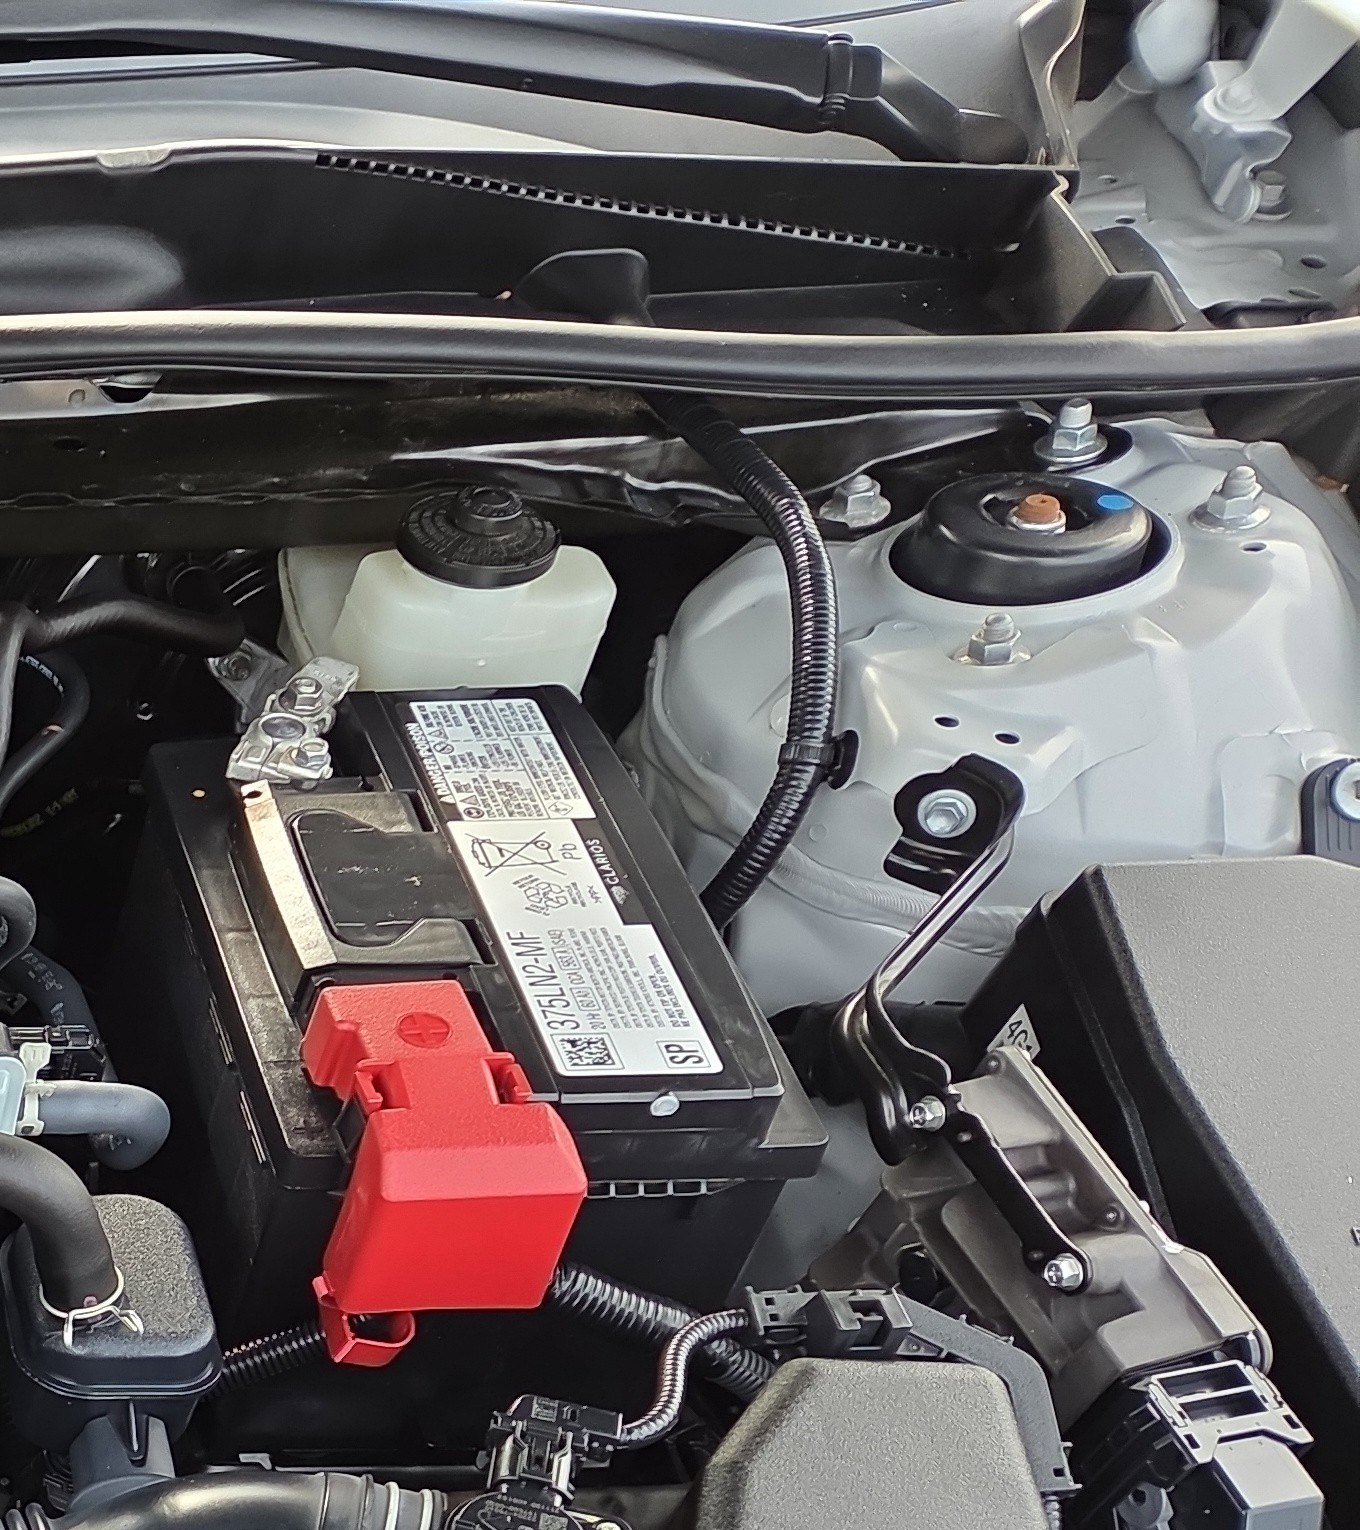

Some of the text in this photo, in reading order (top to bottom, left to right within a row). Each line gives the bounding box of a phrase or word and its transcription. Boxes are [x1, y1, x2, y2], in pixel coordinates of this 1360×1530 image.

[558, 843, 583, 860] Pb
[585, 838, 620, 885] CLARIOS
[506, 931, 580, 1030] 375LN2-MF
[664, 1043, 704, 1065] SP
